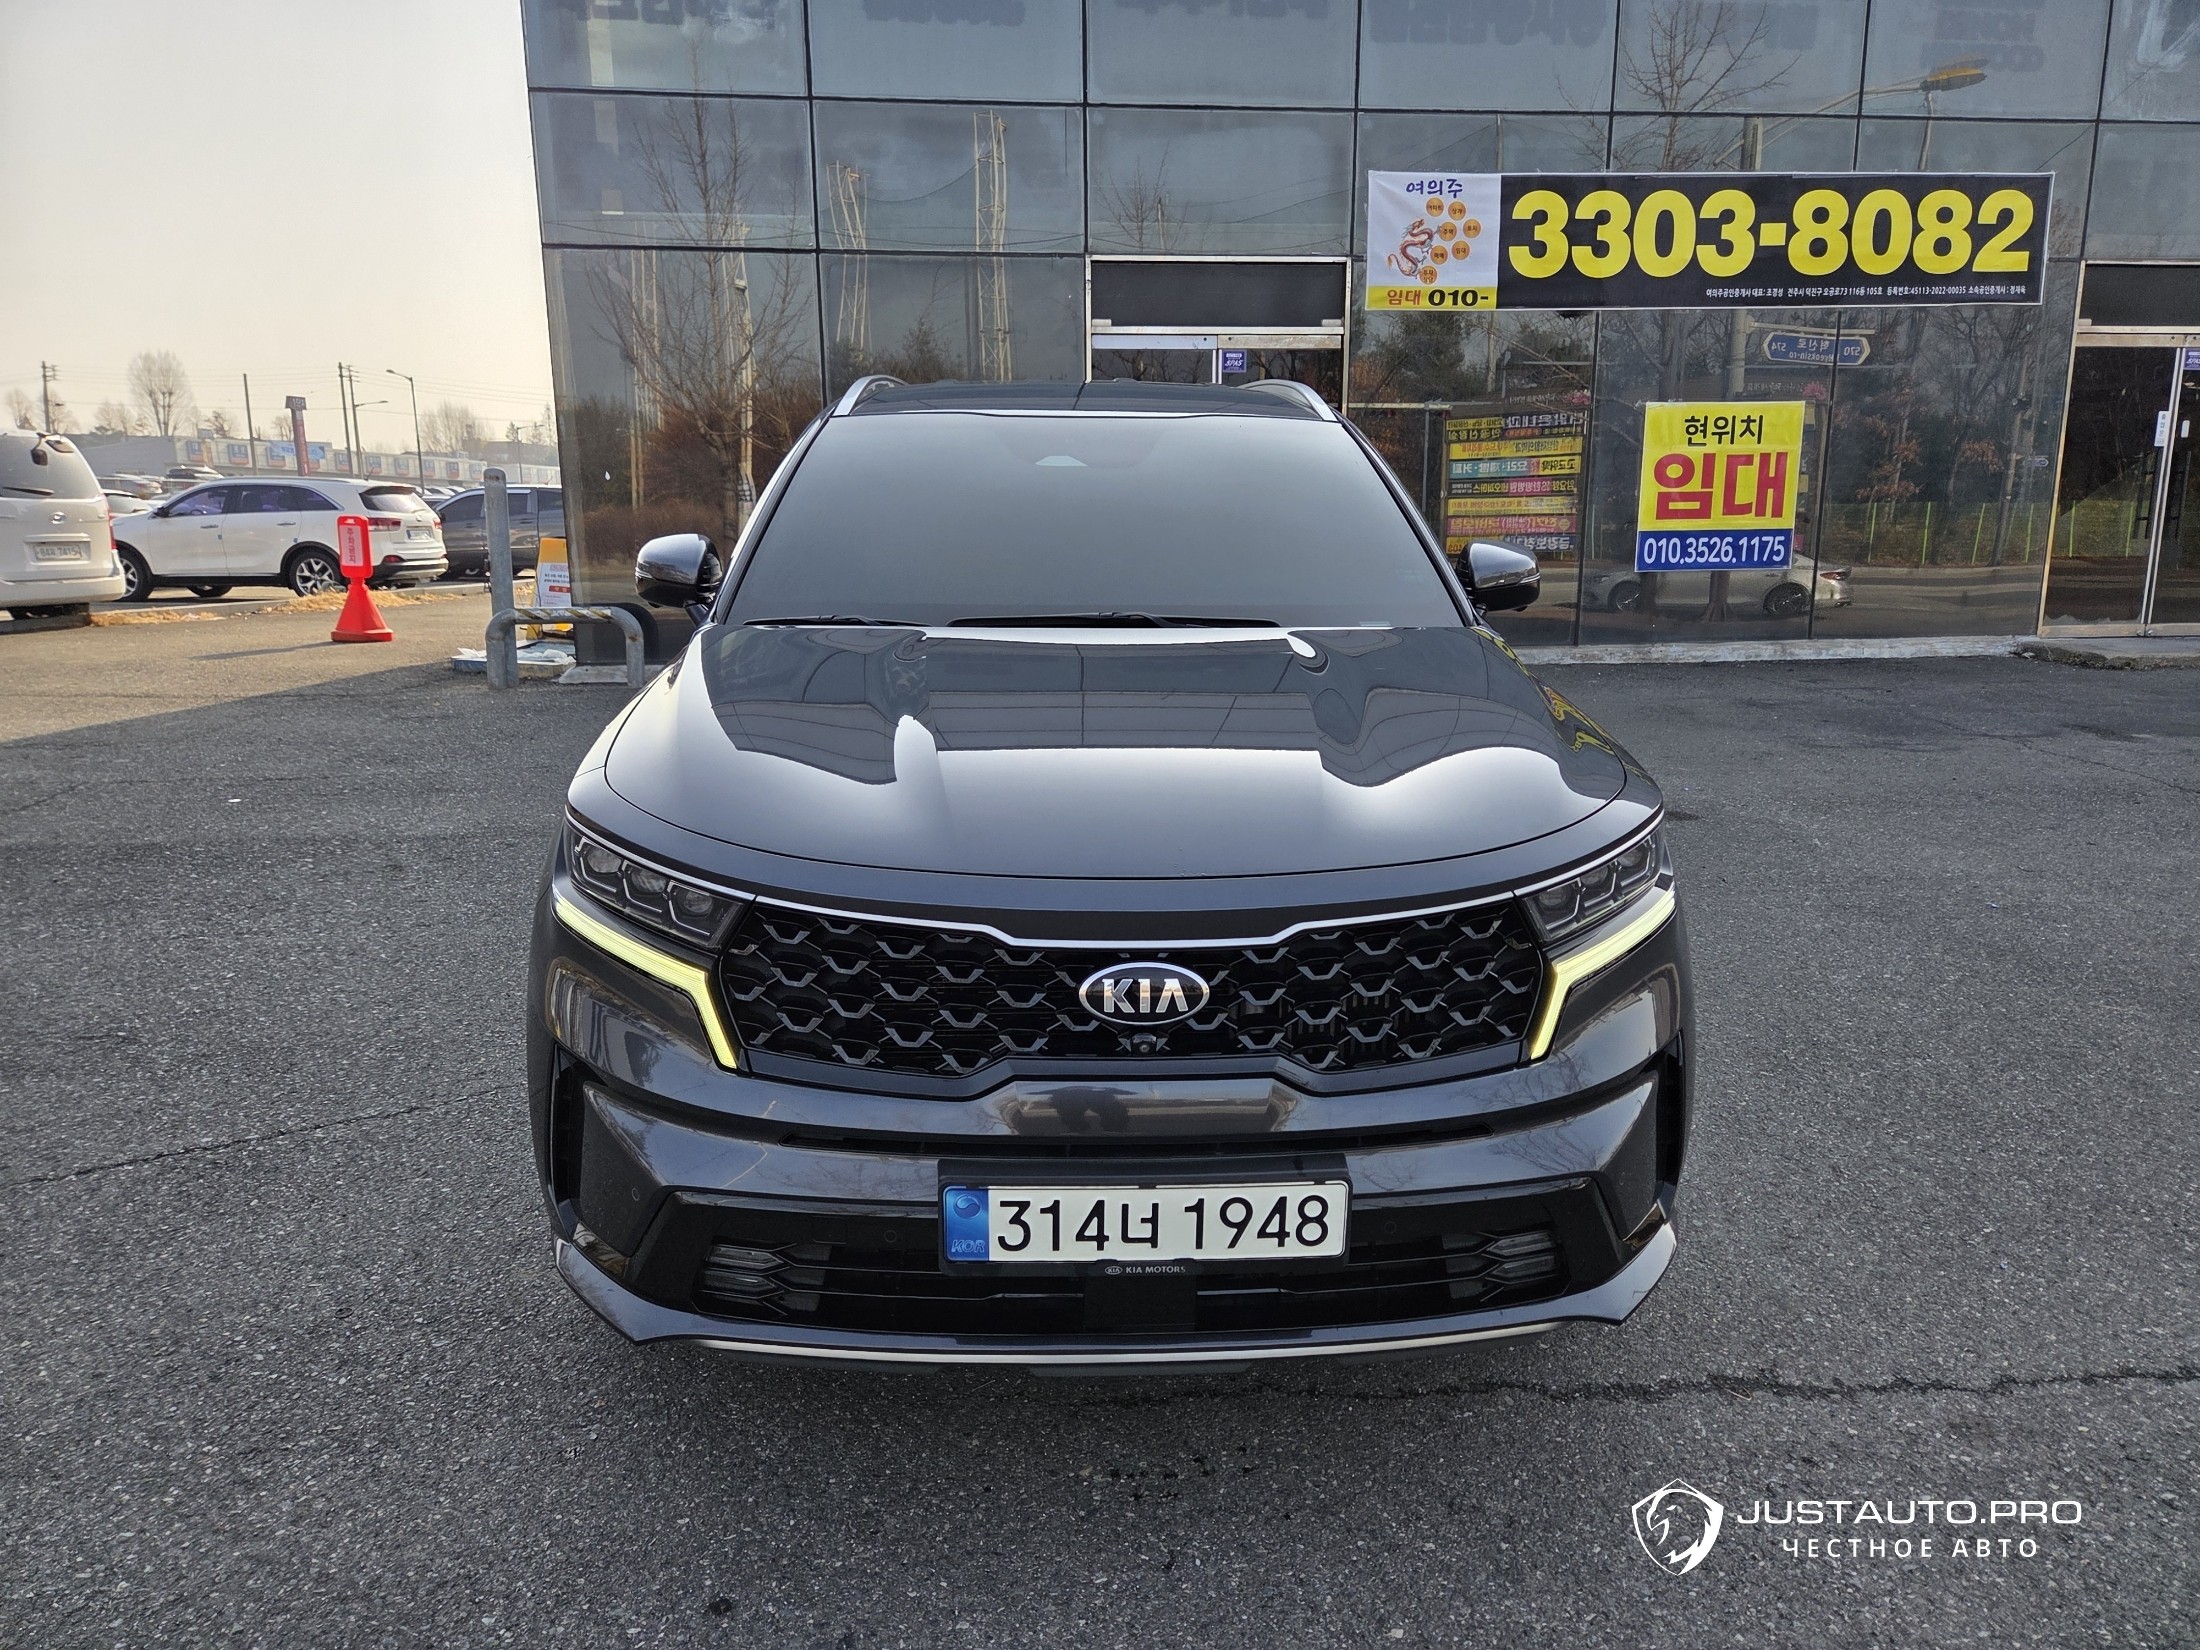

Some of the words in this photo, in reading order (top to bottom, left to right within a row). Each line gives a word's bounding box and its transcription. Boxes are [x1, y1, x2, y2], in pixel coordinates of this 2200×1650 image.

[1406, 179, 1463, 198] 여의주
[1509, 189, 2034, 278] 3303-8082
[1387, 289, 1421, 306] 임대
[1428, 289, 1489, 307] 010-
[1706, 287, 1751, 298] 여의주공인중개사
[1787, 287, 1804, 297] 전주시
[1805, 287, 1822, 296] 덕진구
[1849, 287, 1865, 296] 116동
[1866, 287, 1882, 295] 105호
[1685, 415, 1763, 447] 현위치
[1653, 452, 1788, 520] 임대
[1644, 536, 1785, 565] 010.3526.1175
[1101, 978, 1189, 1015] KIA
[997, 1200, 1159, 1252] 314너
[1184, 1195, 1329, 1250] 1948
[951, 1239, 986, 1253] KOR
[1125, 1266, 1143, 1274] KIA
[1145, 1265, 1186, 1274] MOTORS
